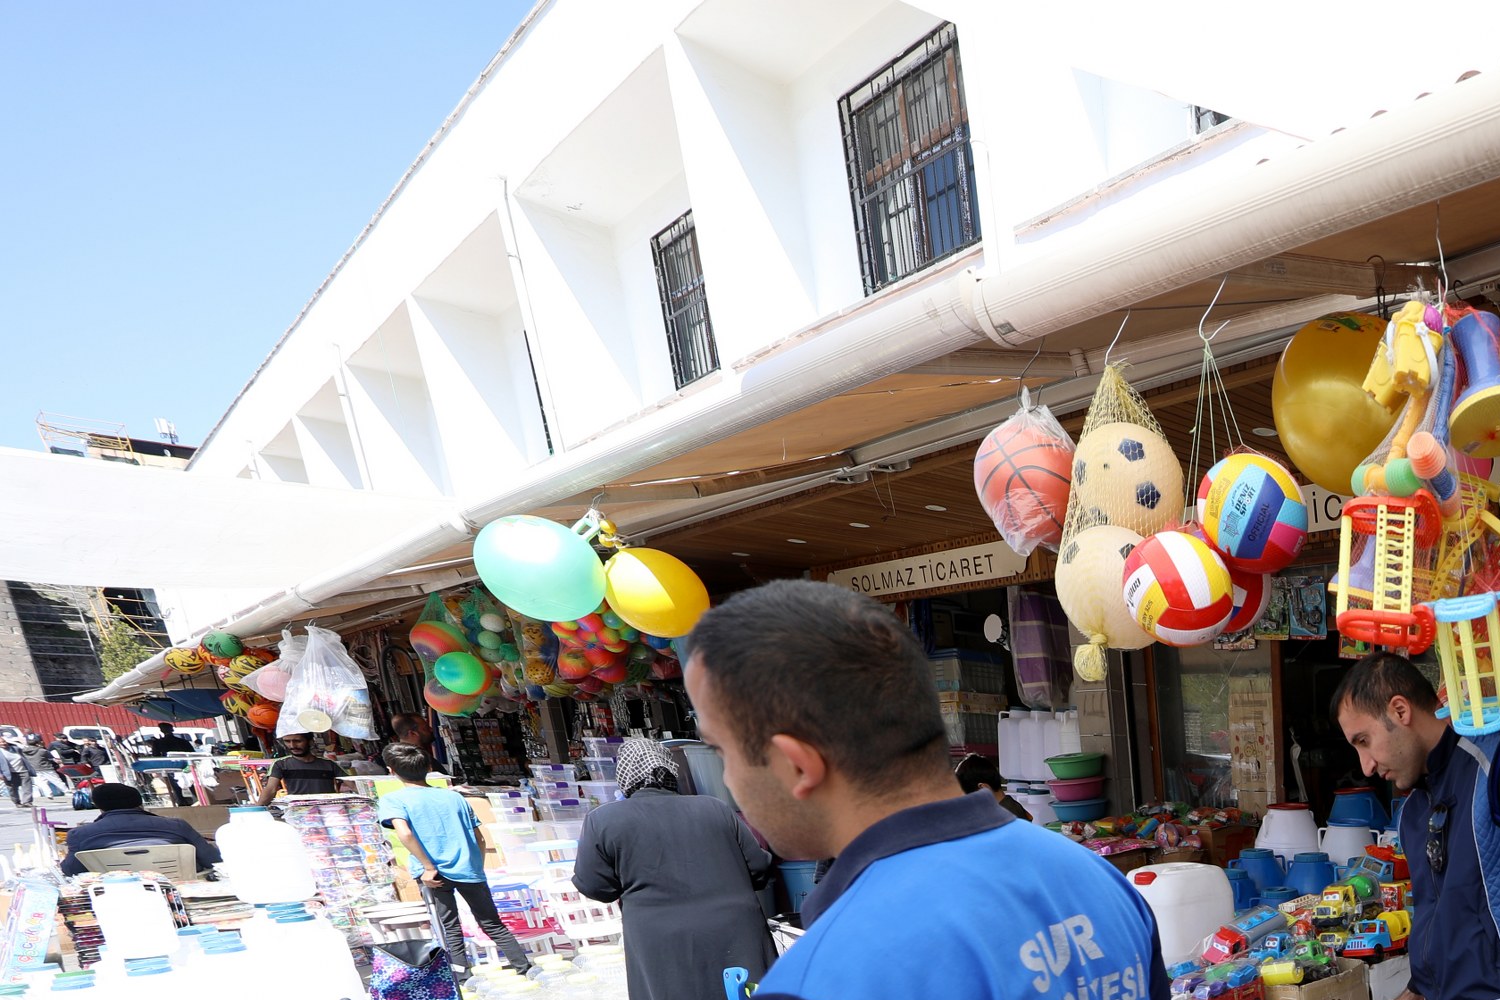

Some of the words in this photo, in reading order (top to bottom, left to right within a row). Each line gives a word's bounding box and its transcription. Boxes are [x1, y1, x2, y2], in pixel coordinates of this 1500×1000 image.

[1247, 502, 1271, 543] OFFICIAL
[851, 567, 916, 593] SOLMAZ
[918, 553, 994, 584] TİCARET
[1019, 914, 1105, 994] SUR
